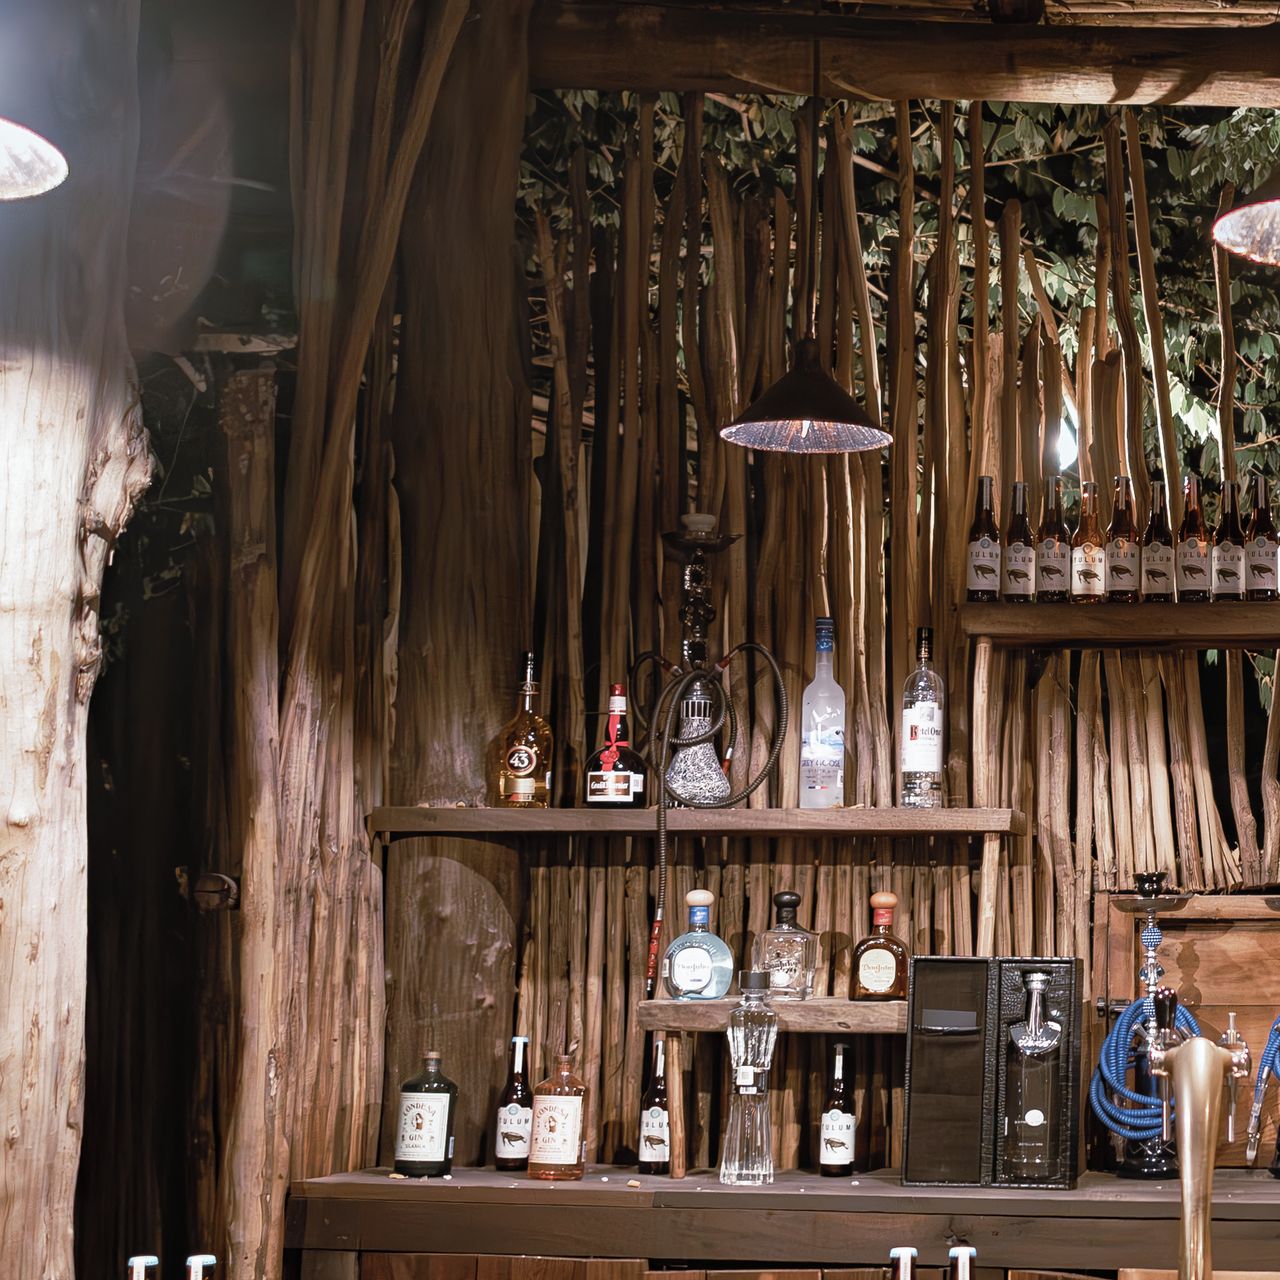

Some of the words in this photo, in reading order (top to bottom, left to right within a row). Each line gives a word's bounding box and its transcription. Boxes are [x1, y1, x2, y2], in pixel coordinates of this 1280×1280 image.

[910, 724, 930, 741] Ktel
[509, 753, 530, 768] 43
[542, 1136, 556, 1144] GIN
